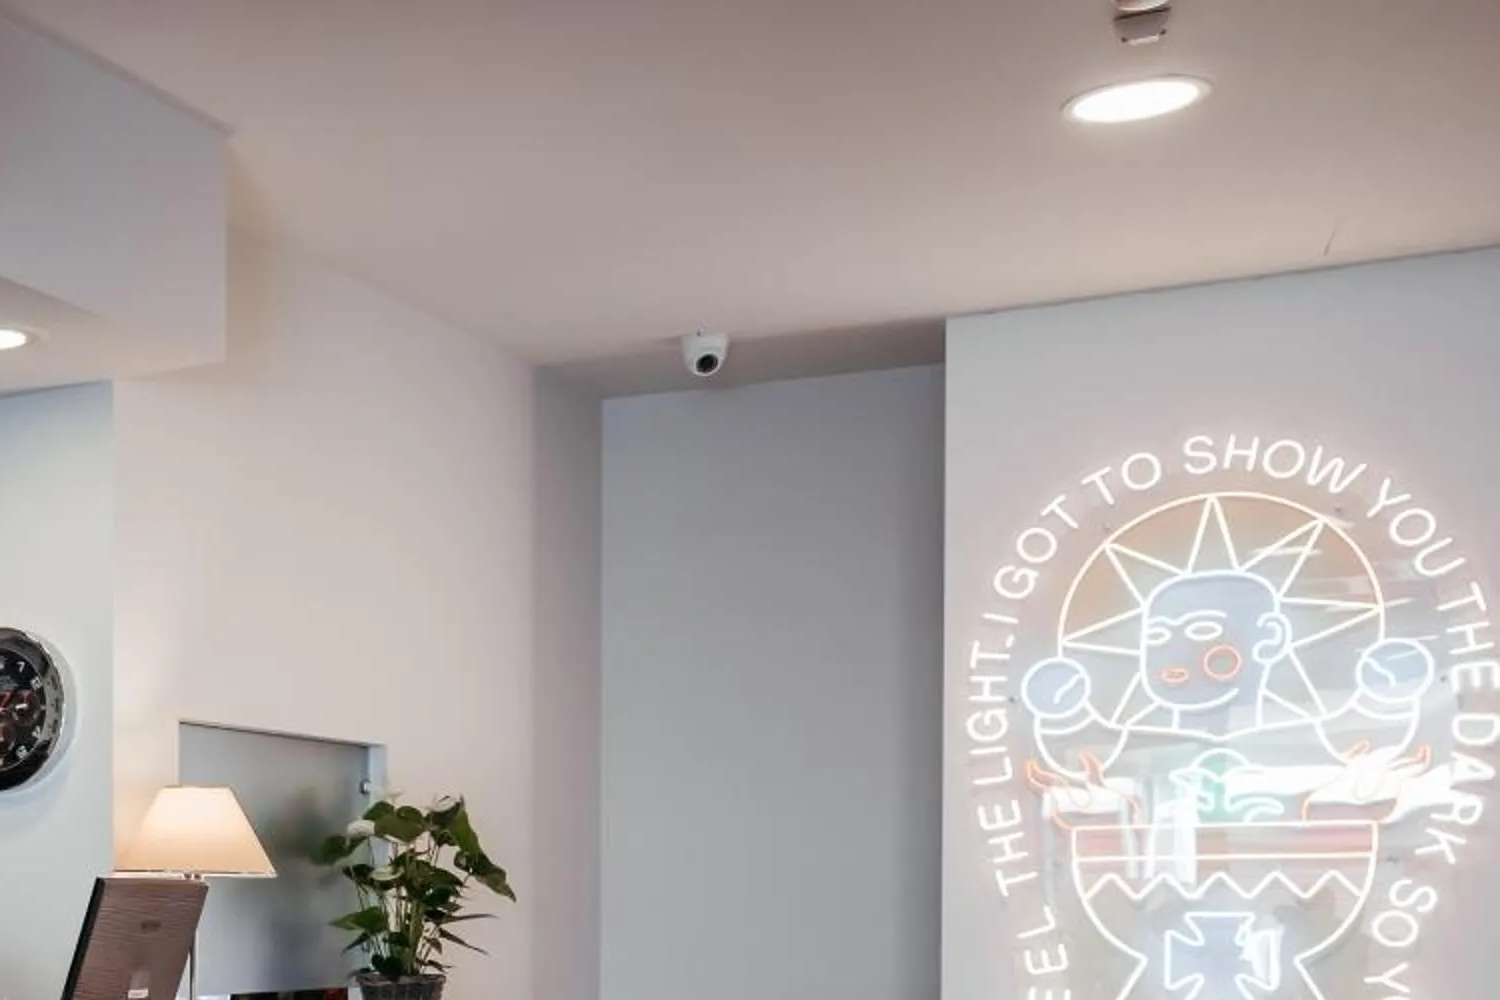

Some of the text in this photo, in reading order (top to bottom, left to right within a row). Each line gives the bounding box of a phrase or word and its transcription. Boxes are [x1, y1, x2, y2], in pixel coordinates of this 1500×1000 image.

[1080, 452, 1162, 505] TO
[1182, 433, 1368, 494] SHOW
[993, 494, 1079, 600] GOT
[1366, 477, 1467, 577] YOU
[982, 612, 1019, 625] I
[1436, 581, 1500, 694] THE
[1414, 713, 1500, 865] DARK
[977, 799, 1038, 897] THE
[1371, 879, 1438, 948] SO
